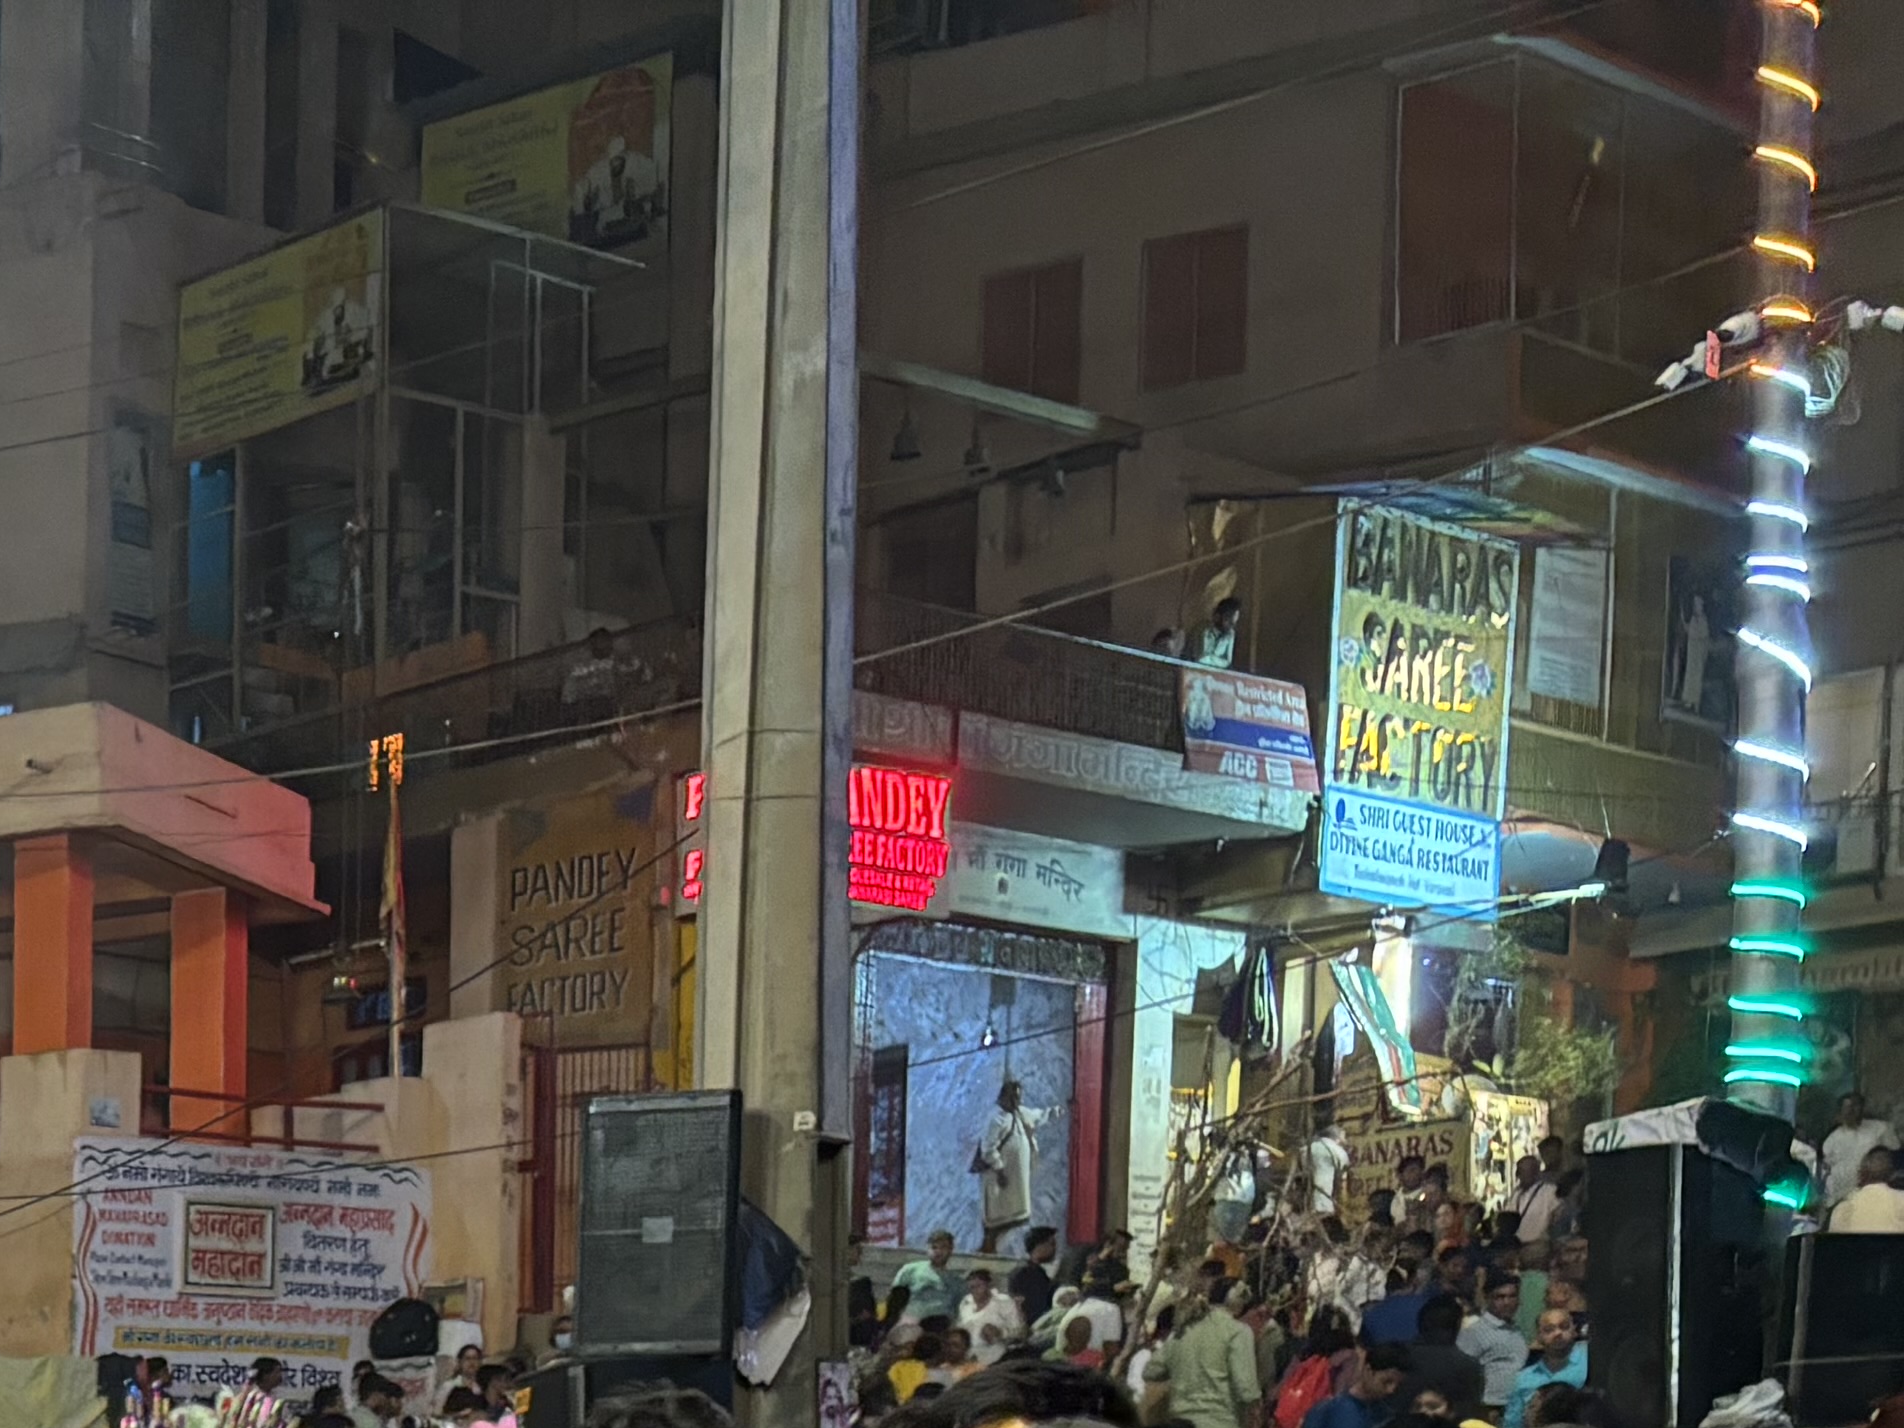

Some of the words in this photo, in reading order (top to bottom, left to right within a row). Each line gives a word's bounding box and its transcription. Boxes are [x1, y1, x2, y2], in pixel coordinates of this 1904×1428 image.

[1345, 511, 1515, 629] BANARAS
[1360, 611, 1476, 713] SAREE
[1219, 751, 1259, 779] ACC
[1335, 703, 1498, 811] FACTORY
[1360, 804, 1389, 829] SHRI
[1393, 810, 1432, 837] GUEST
[1435, 819, 1475, 846] HOUSE
[511, 847, 636, 912] PANDEY
[875, 835, 950, 878] FACTORY
[1372, 837, 1414, 868] GANGA
[1417, 847, 1490, 882] RESTAURANT
[508, 907, 627, 967] SAREE
[507, 967, 630, 1017] FACTORY
[191, 1209, 266, 1244] अन्नदान
[191, 1250, 266, 1280] महादान
